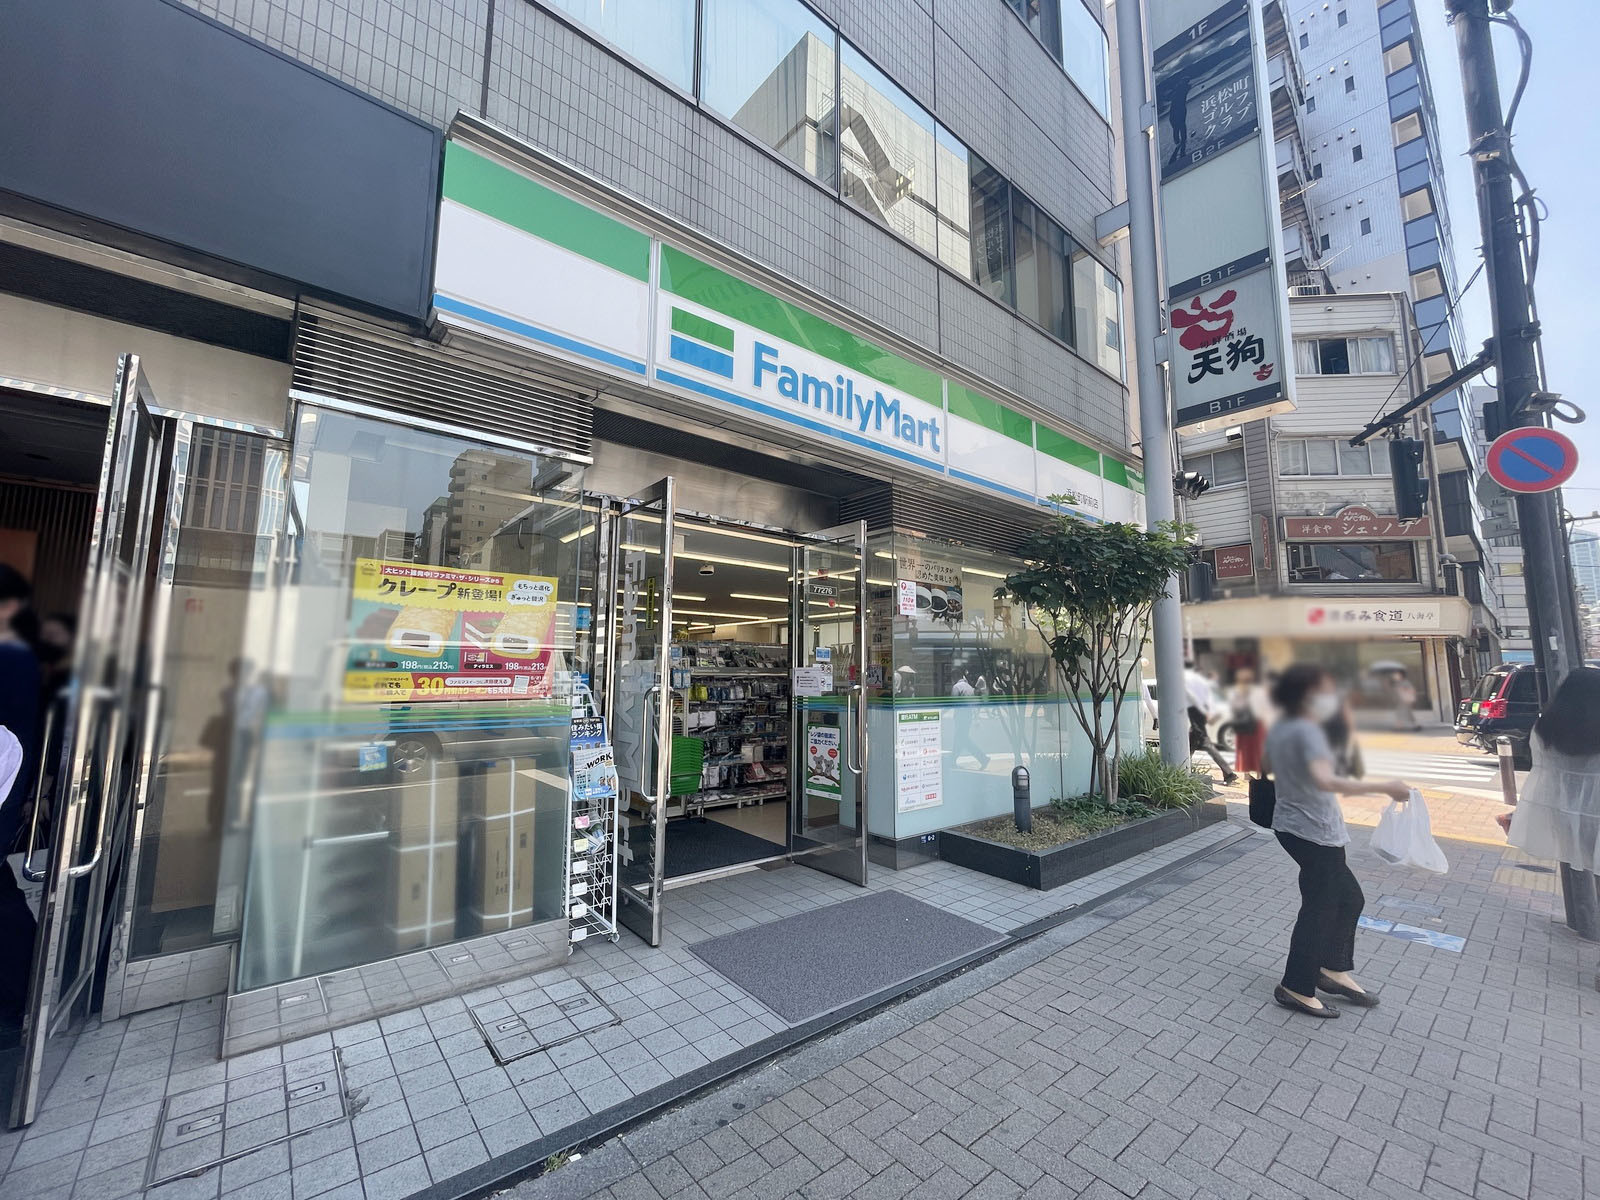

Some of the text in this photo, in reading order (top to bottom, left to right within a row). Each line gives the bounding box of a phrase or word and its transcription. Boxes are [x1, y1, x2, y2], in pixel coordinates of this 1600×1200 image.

[1188, 19, 1209, 40] 1F
[1200, 75, 1250, 114] 浜松町
[1203, 91, 1249, 124] ゴルフ
[1204, 101, 1253, 140] クラブ
[1191, 139, 1226, 163] B2F
[1200, 264, 1236, 287] B1F
[1187, 334, 1265, 385] 天狗
[752, 341, 941, 453] FamilyMart
[1209, 395, 1247, 414] B1F
[586, 751, 613, 769] WORK
